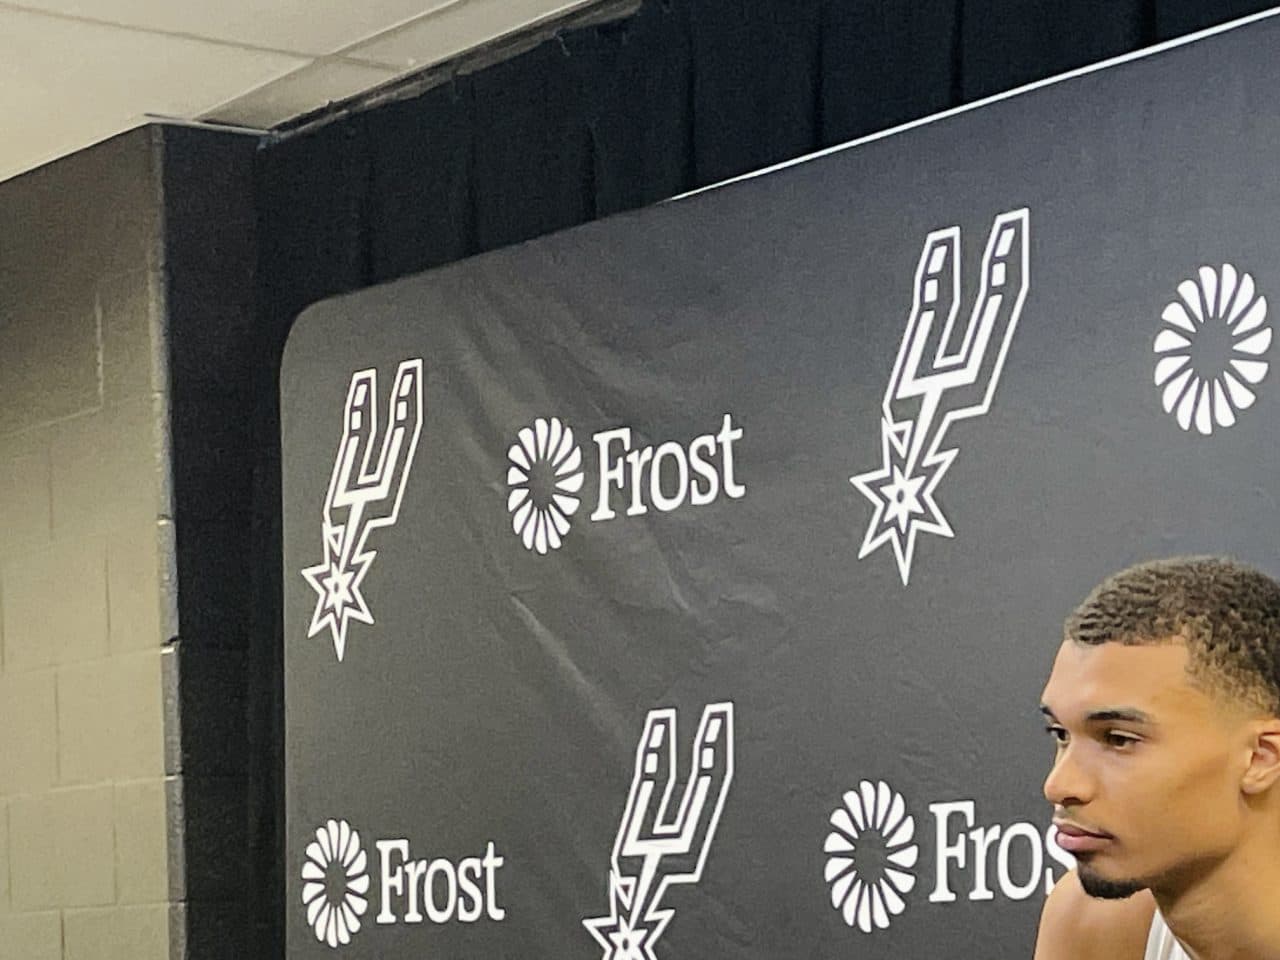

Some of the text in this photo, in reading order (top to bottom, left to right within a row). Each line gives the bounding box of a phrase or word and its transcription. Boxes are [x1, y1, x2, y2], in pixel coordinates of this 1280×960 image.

[590, 413, 746, 522] Frost
[375, 839, 506, 924] Frost
[928, 800, 1078, 903] Fros
